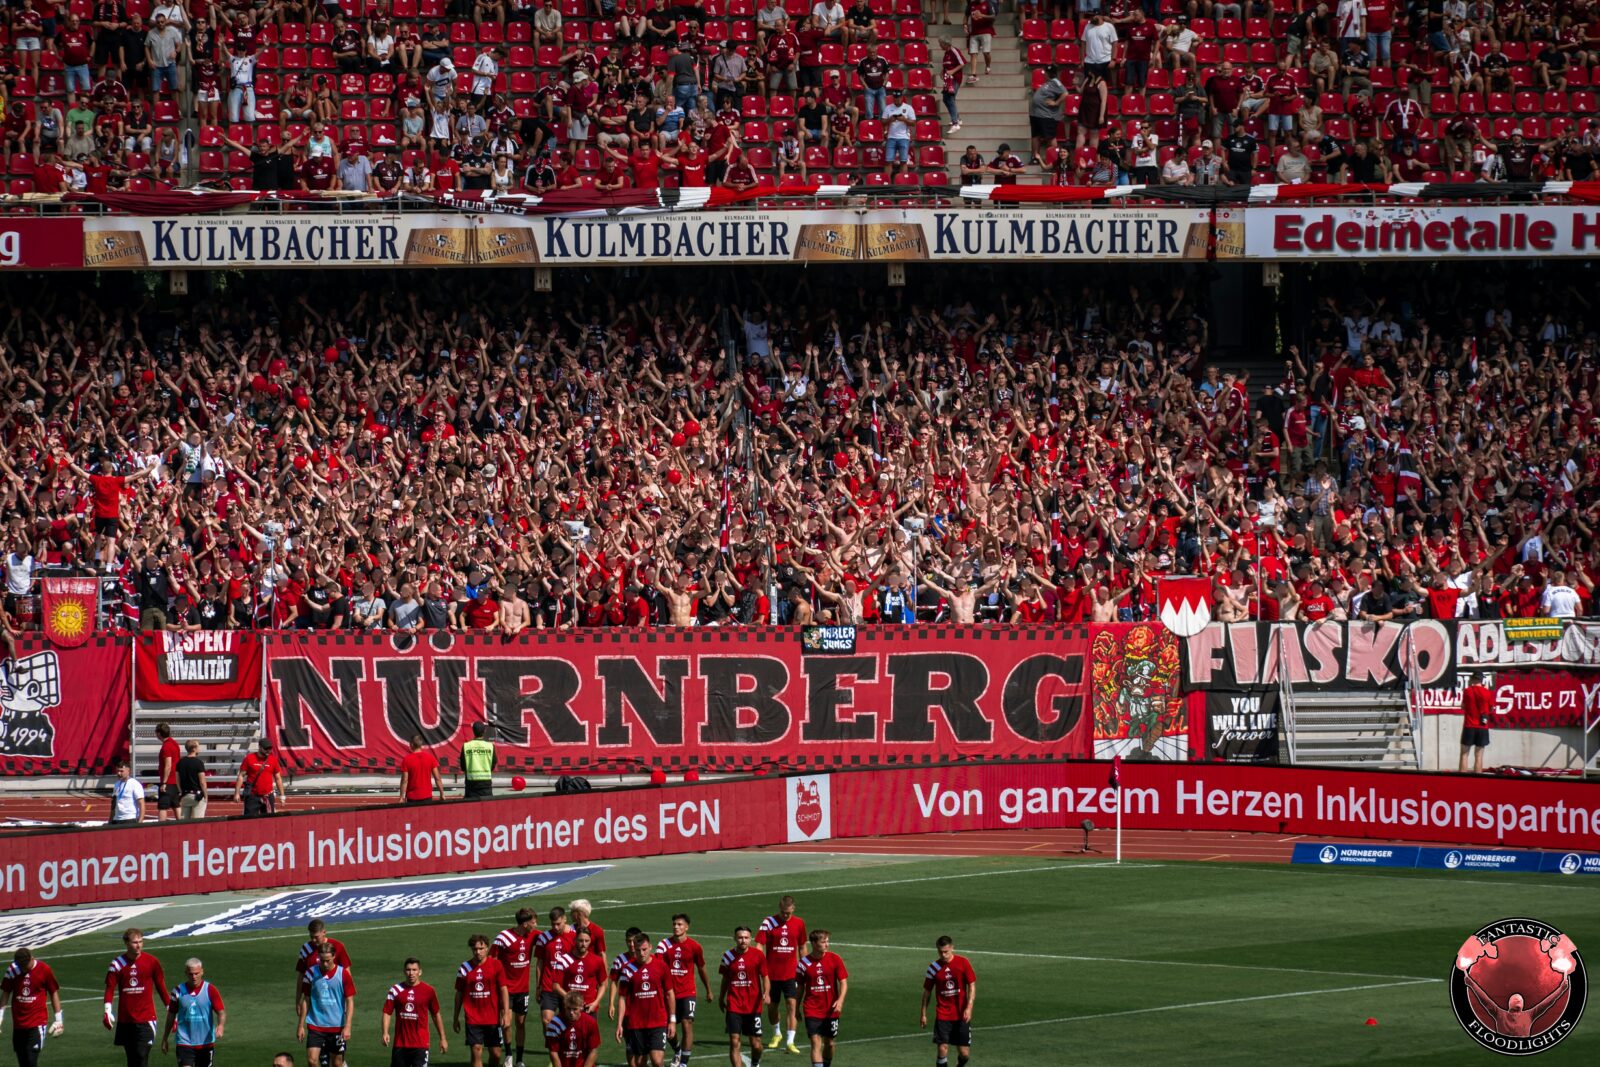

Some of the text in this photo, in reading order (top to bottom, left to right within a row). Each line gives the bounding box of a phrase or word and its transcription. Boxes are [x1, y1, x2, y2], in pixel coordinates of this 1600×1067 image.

[152, 220, 400, 261] KULMBACHER
[543, 216, 790, 258] KULMBACHER
[933, 213, 1180, 254] KULMBACHER
[475, 240, 532, 264] KULMBACHER
[800, 239, 857, 258] KULMBACHER
[162, 630, 235, 652] RESPEKT
[818, 627, 855, 639] MARLER
[822, 639, 853, 649] JUNGS
[1187, 619, 1451, 685] FIASKO
[166, 655, 232, 680] RIVALITÄT
[270, 631, 1085, 750] NÜRNBERG
[1230, 697, 1260, 714] YOU
[1212, 713, 1277, 730] WILL LIVE
[10, 727, 47, 746] 1994
[913, 782, 983, 818] Von
[999, 785, 1159, 823] ganzem
[1176, 780, 1303, 819] Herzen
[38, 851, 169, 900] ganzem
[182, 839, 296, 878] Herzen
[308, 814, 585, 868] Inklusionspartner
[594, 807, 648, 844] des
[659, 799, 720, 839] FCN
[1340, 849, 1393, 858] NÜRNBERGER
[1465, 853, 1517, 863] NÜRNBERGER
